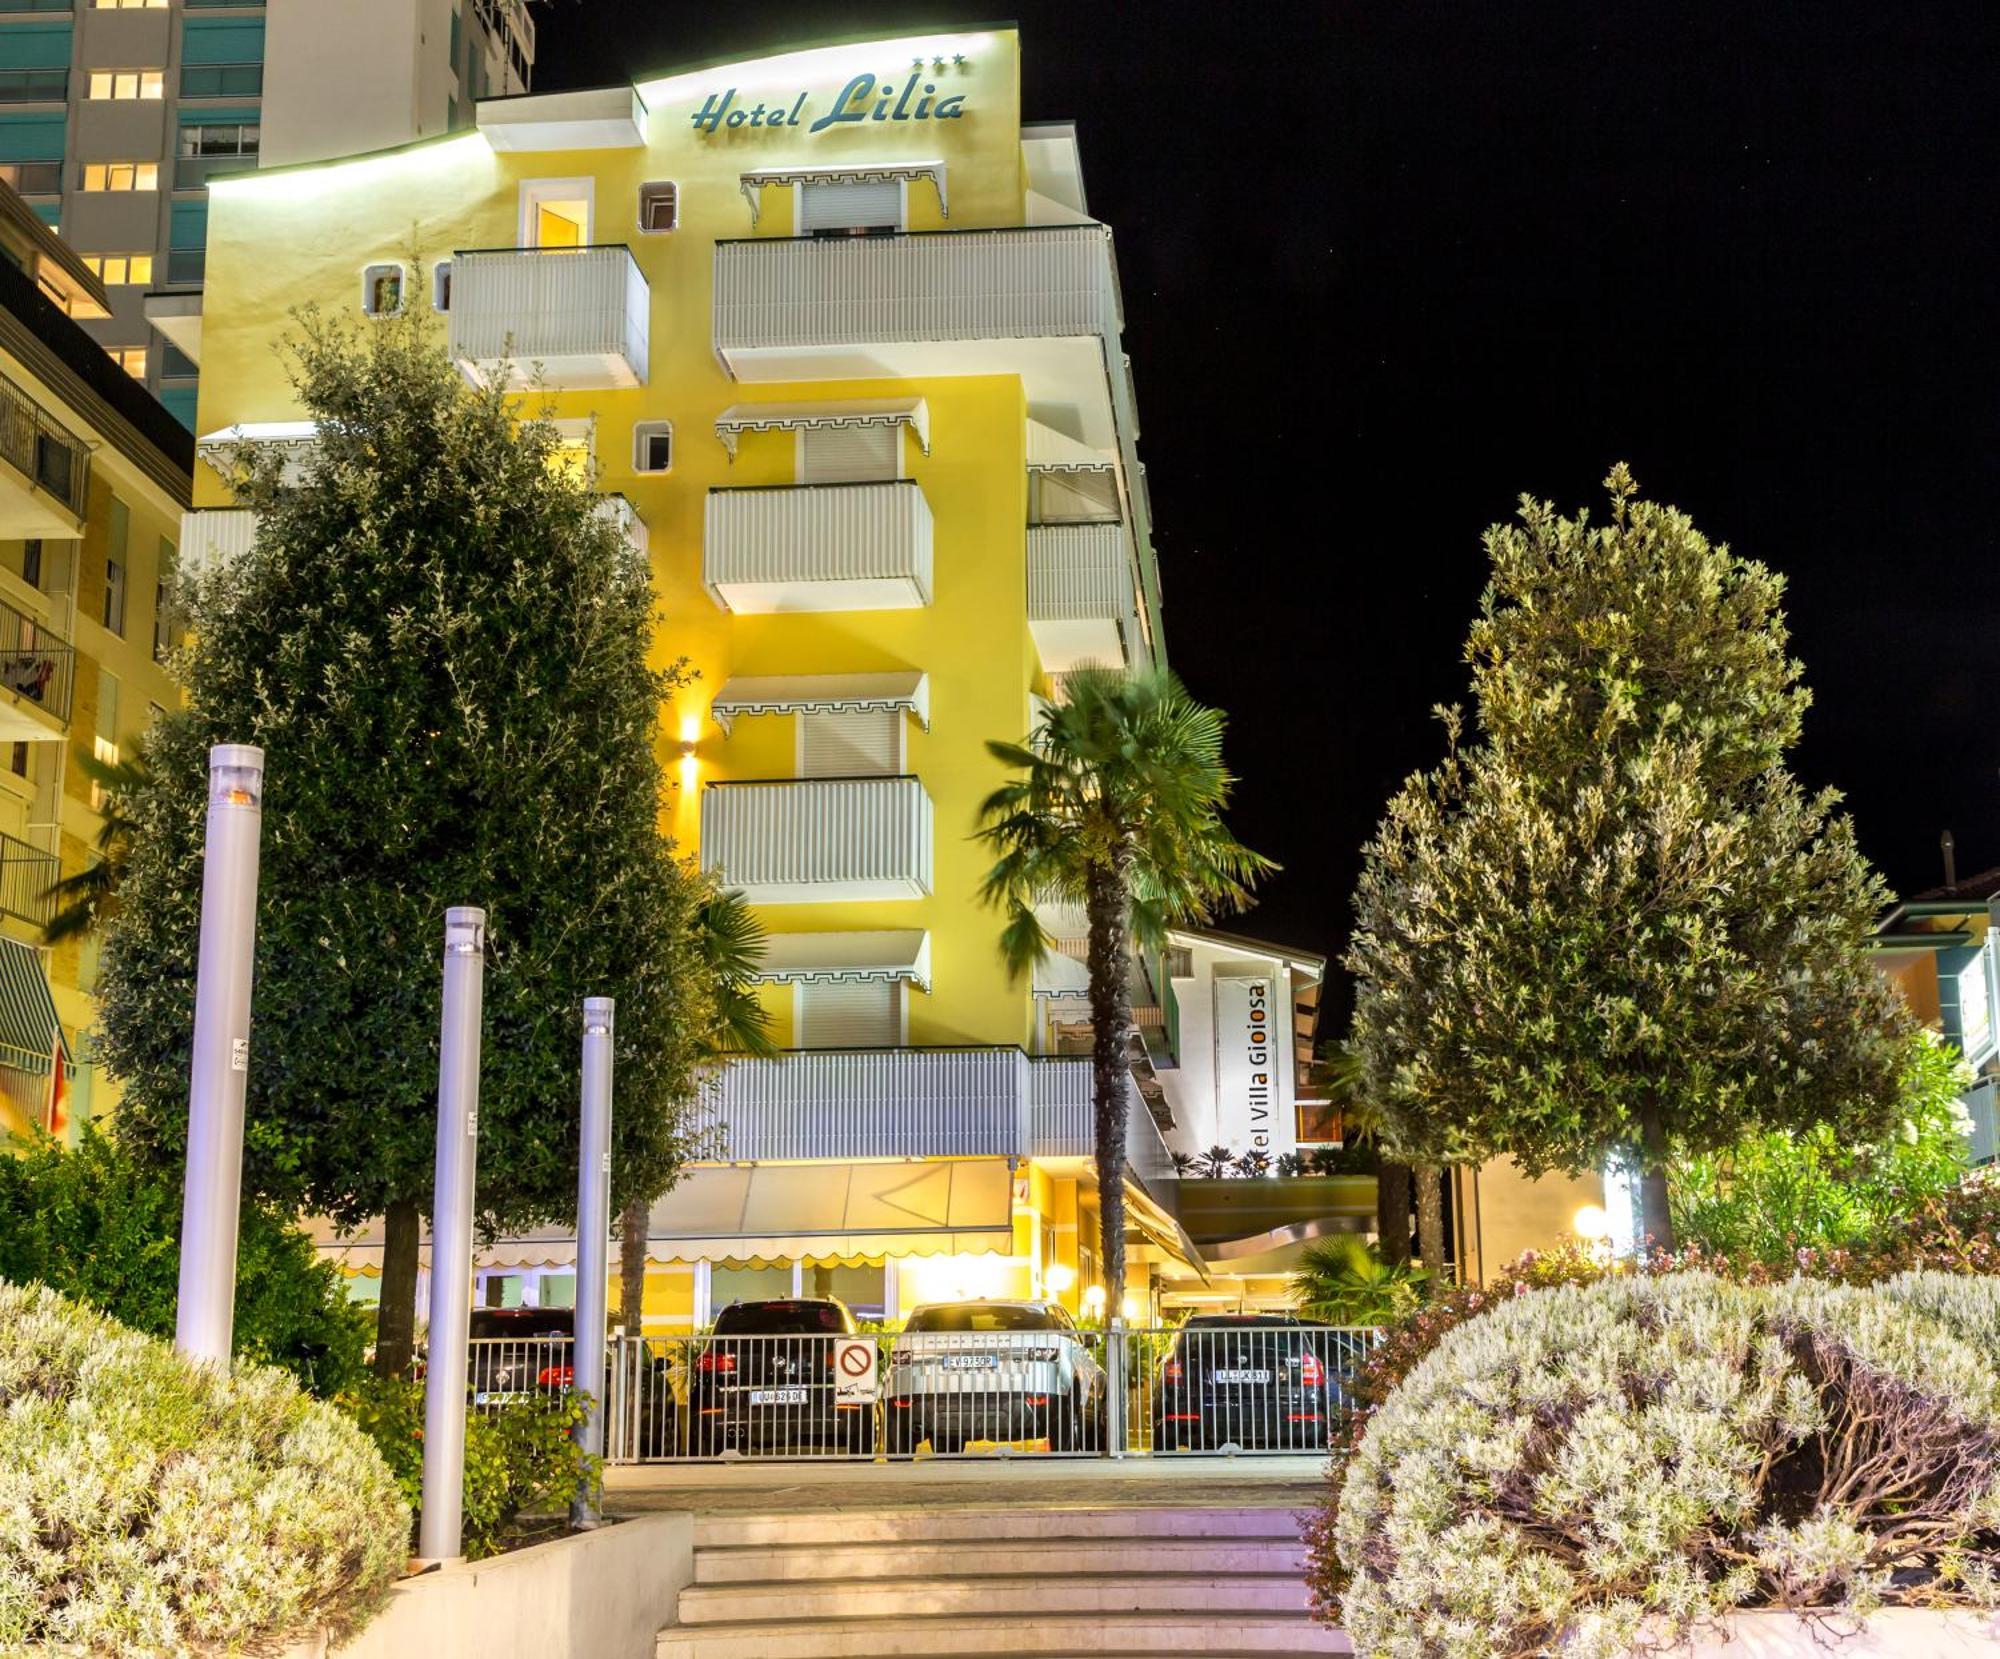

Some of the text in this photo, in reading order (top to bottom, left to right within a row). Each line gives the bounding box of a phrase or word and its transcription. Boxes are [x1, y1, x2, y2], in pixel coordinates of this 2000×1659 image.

[690, 72, 967, 134] Hotel Lilia
[1247, 984, 1268, 1066] Gioiosa
[1249, 1072, 1269, 1121] Villa
